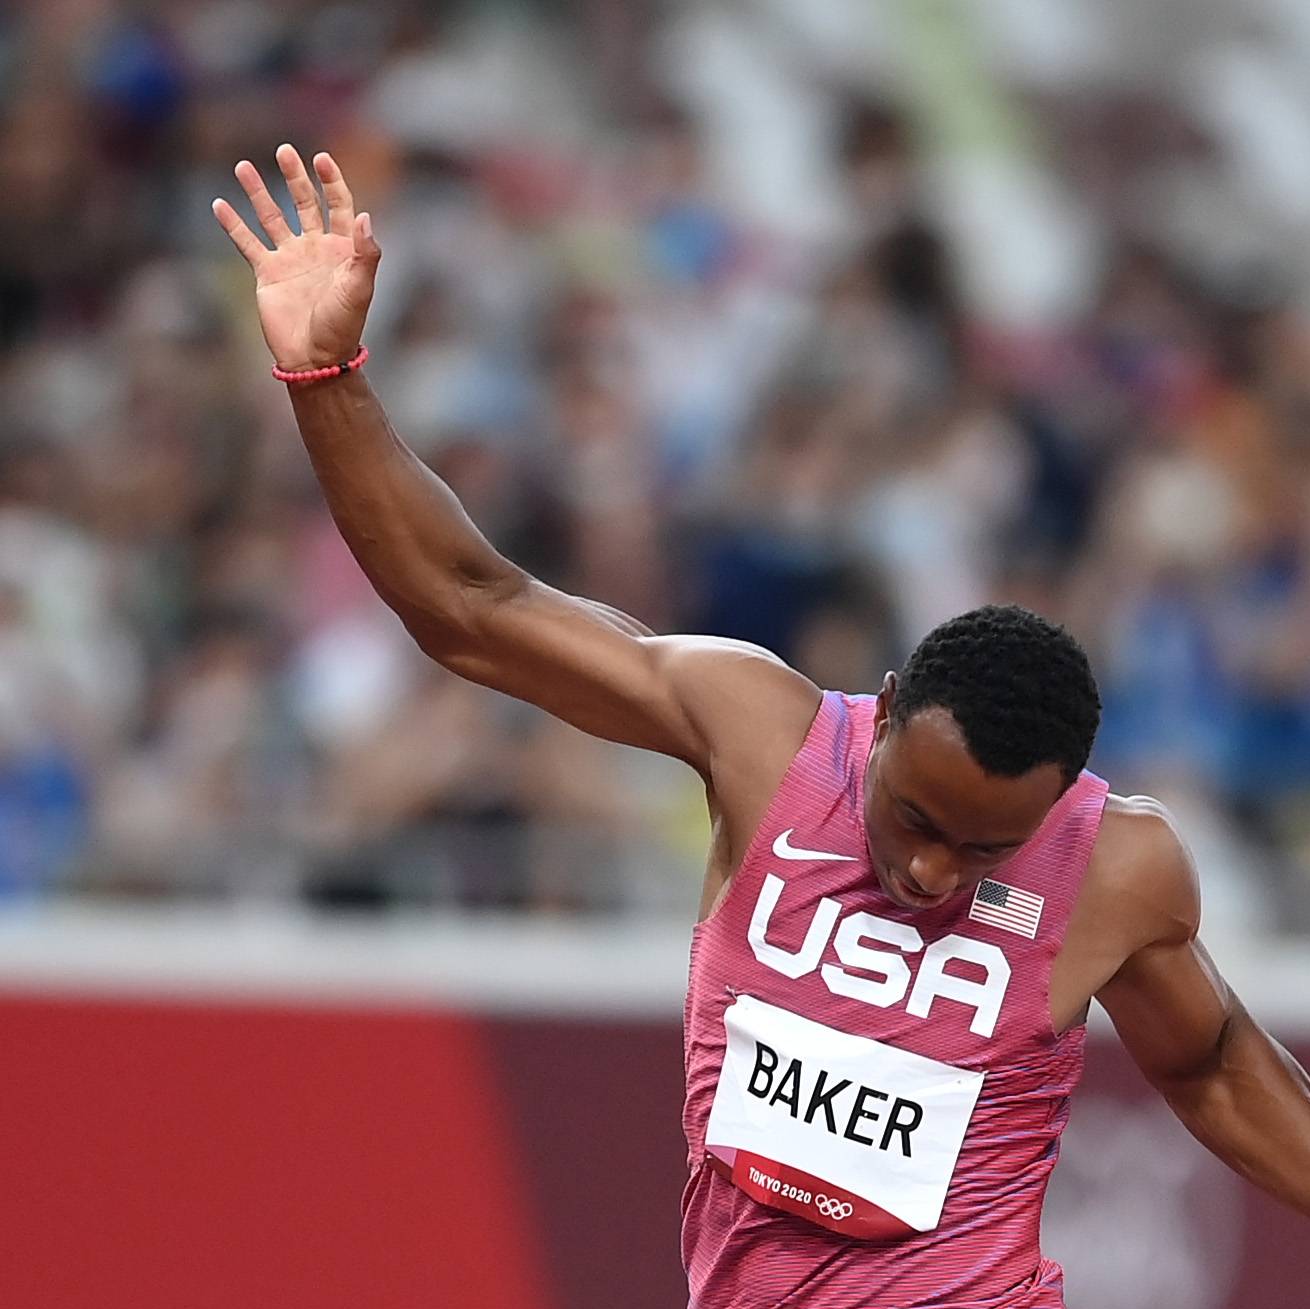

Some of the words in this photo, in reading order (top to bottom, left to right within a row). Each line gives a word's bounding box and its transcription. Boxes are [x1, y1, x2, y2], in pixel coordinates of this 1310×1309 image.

[747, 872, 1012, 1039] USA
[746, 1040, 924, 1158] BAKER
[748, 1166, 781, 1193] TOKYO
[780, 1184, 812, 1204] 2020
